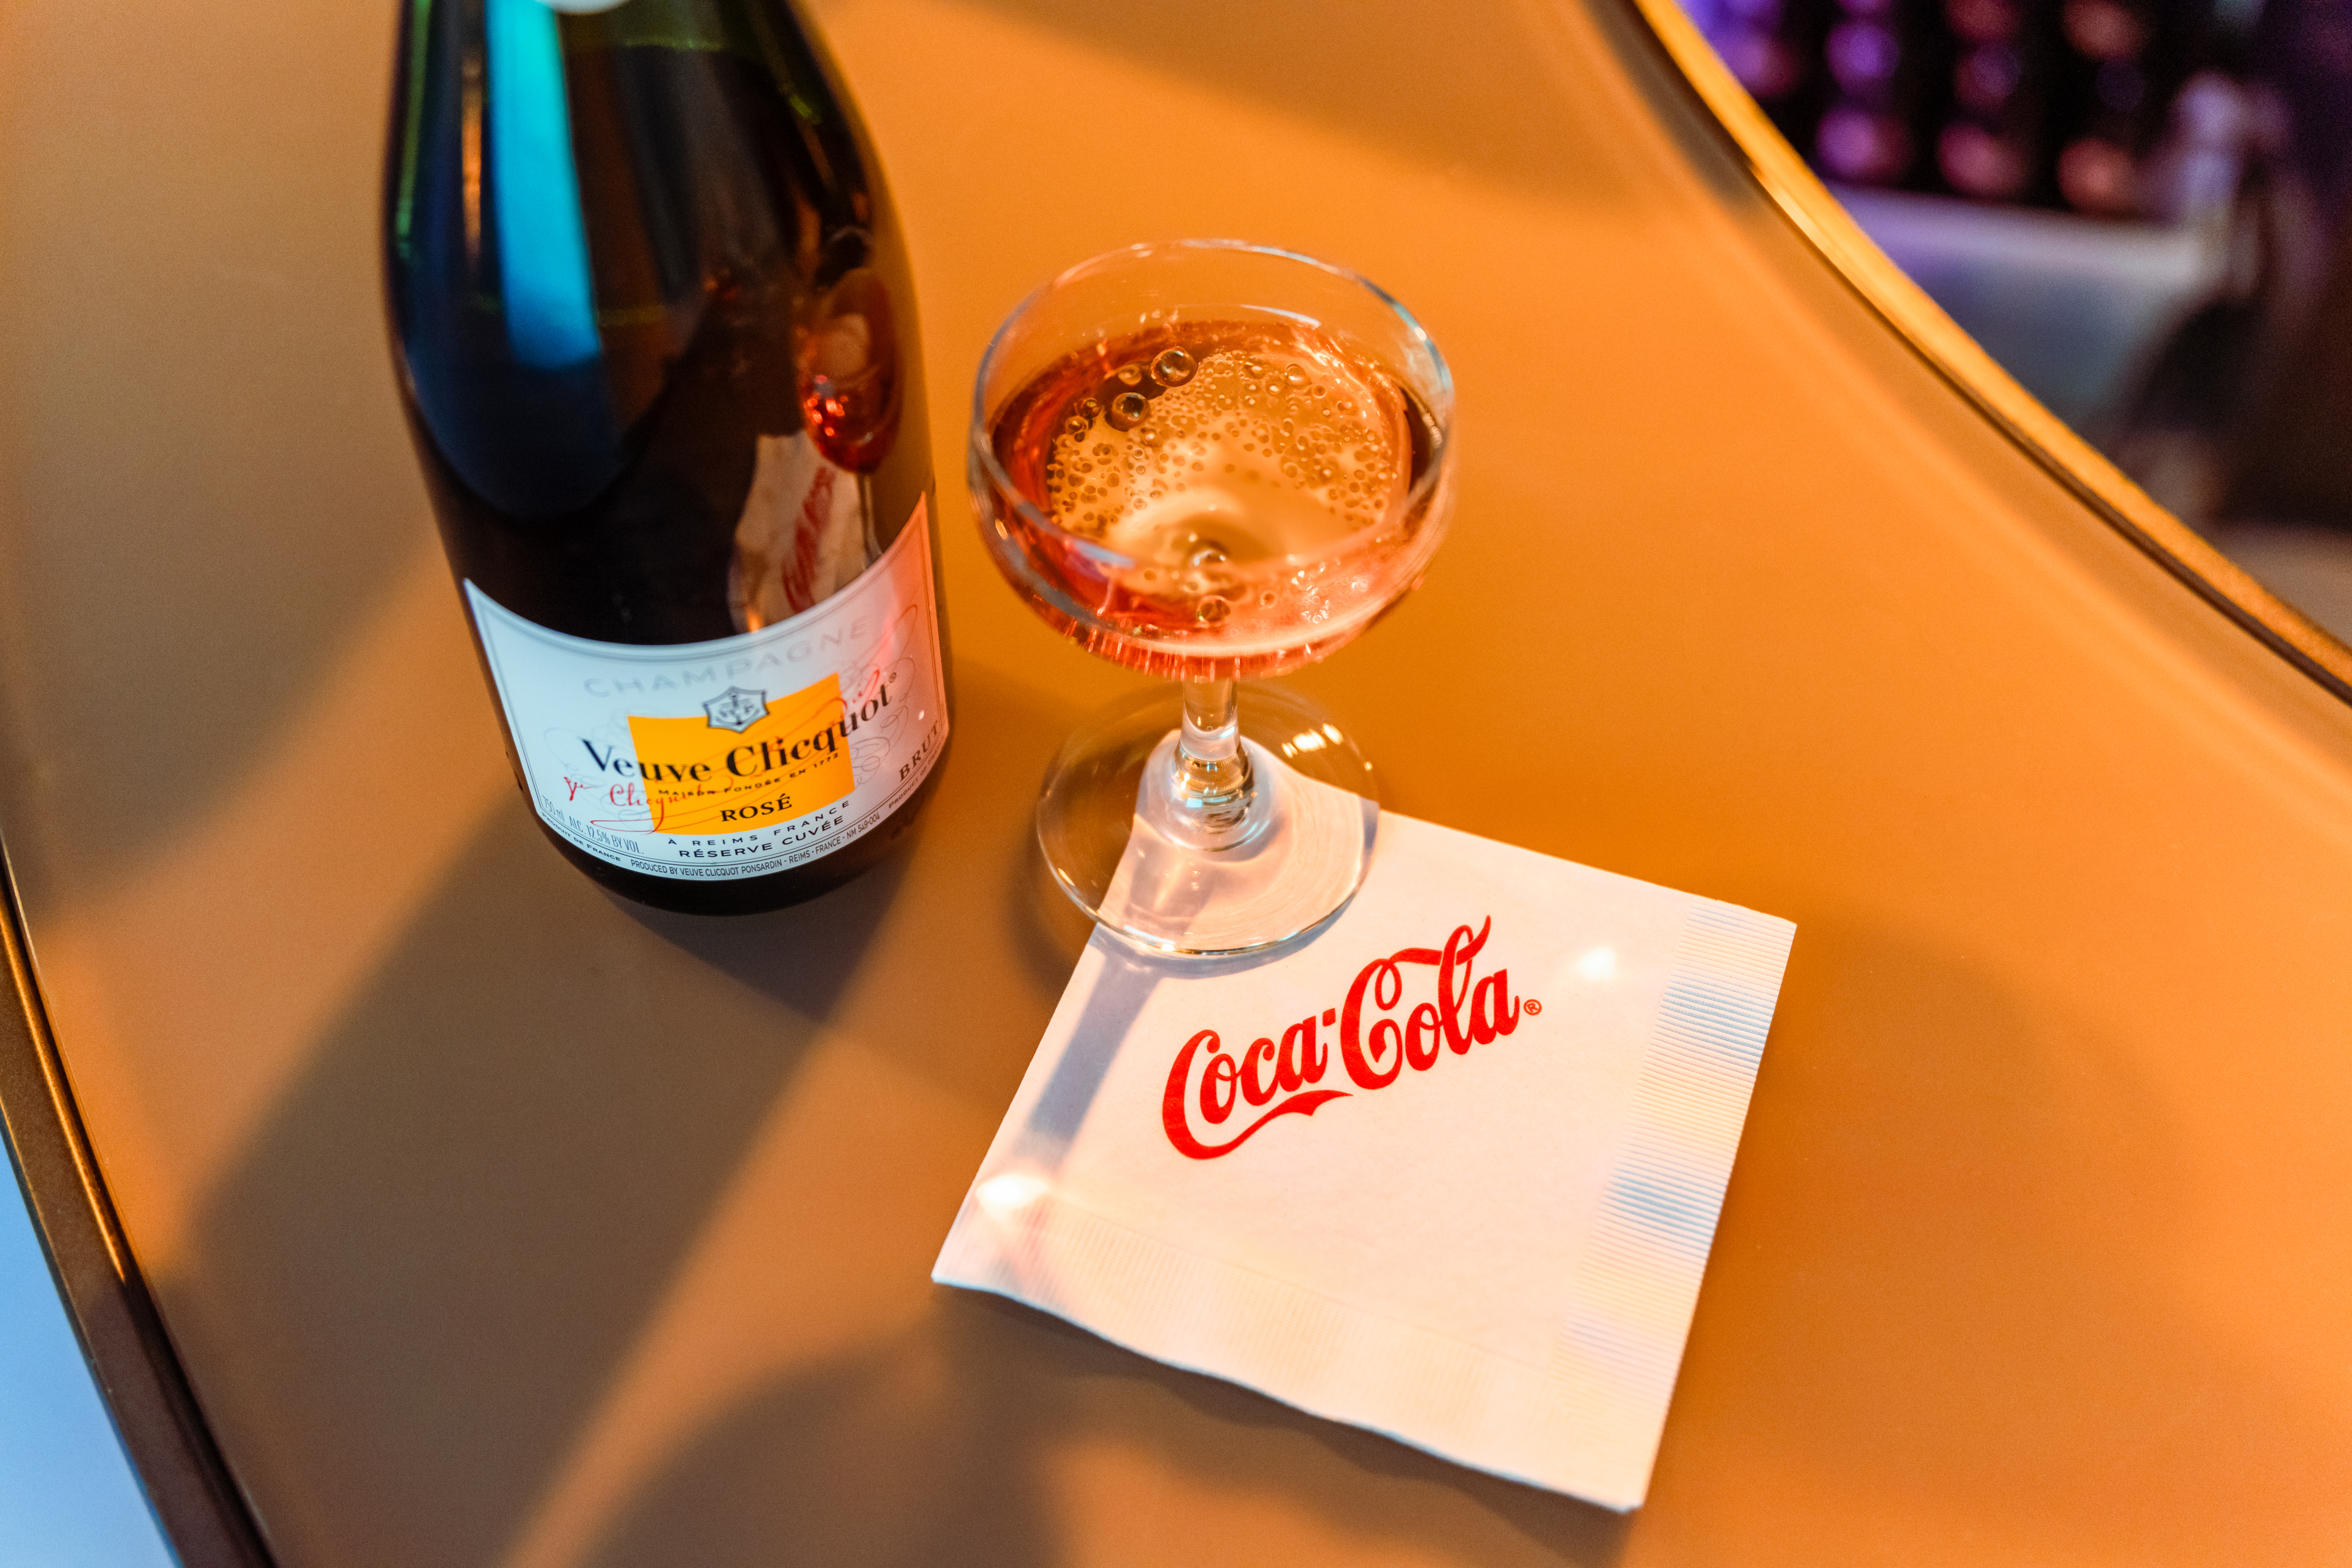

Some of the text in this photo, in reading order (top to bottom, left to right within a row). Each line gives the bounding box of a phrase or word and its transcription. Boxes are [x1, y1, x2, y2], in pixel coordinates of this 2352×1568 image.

[583, 614, 868, 698] CHAMPAGNE
[580, 738, 712, 783] Veuve
[899, 719, 938, 782] BRUT
[724, 777, 781, 793] FONDÉE
[789, 769, 805, 778] EN
[889, 777, 919, 809] PRODUCT
[542, 795, 644, 854] 750 ml ALC. 12,5% BY VOL.
[692, 835, 758, 846] REIMS
[773, 800, 849, 836] FRANCE
[719, 793, 792, 822] ROSÉ
[542, 812, 571, 838] PRODUIT
[587, 843, 621, 862] FRANCE
[631, 859, 668, 873] PRODUCED
[670, 867, 678, 875] BY
[680, 867, 704, 876] VEUVE
[705, 867, 739, 877] CLICQUOT
[742, 858, 783, 874] PONSARDIN
[789, 850, 811, 864] REIMS
[815, 836, 841, 854] FRANCE
[847, 827, 856, 839] NM
[858, 812, 880, 833] 549-004
[679, 815, 843, 858] RÉSERVE CUVÉE
